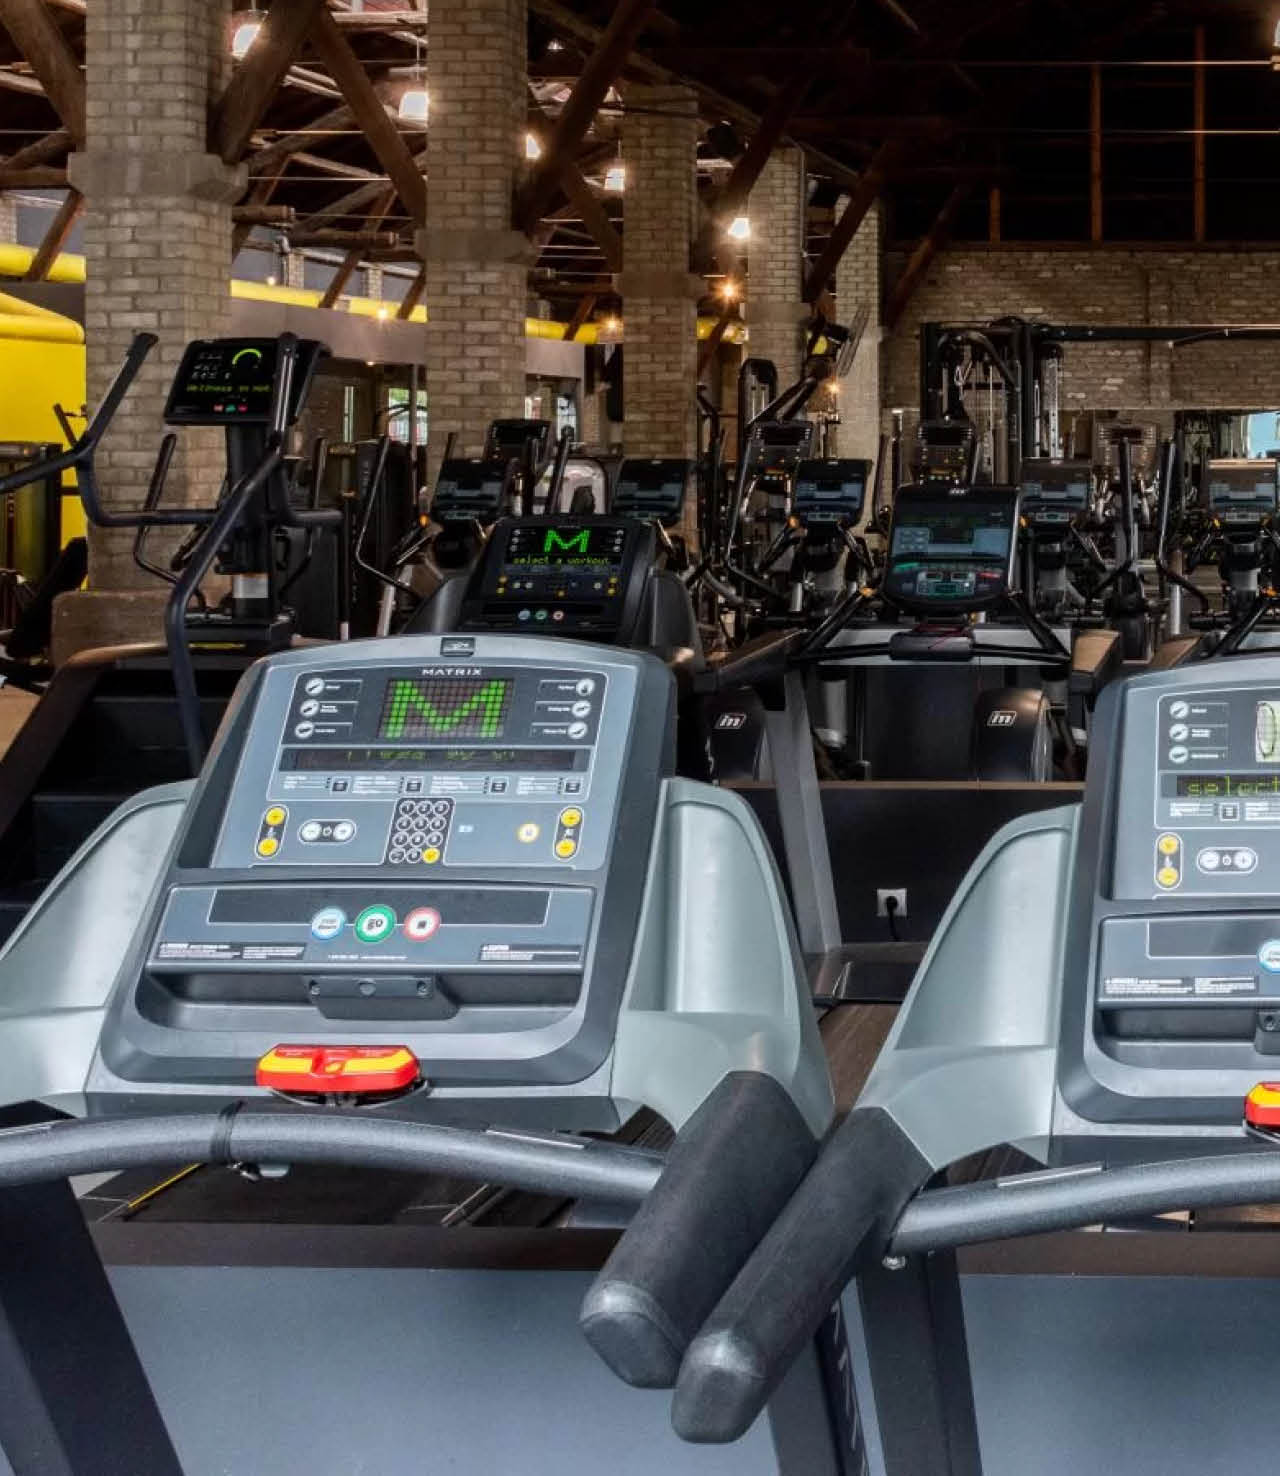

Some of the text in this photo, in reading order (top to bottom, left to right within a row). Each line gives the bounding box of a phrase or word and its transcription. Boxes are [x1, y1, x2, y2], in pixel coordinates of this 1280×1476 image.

[543, 529, 591, 553] M
[512, 554, 549, 565] select
[421, 668, 481, 676] MATRIX
[384, 681, 506, 738] M
